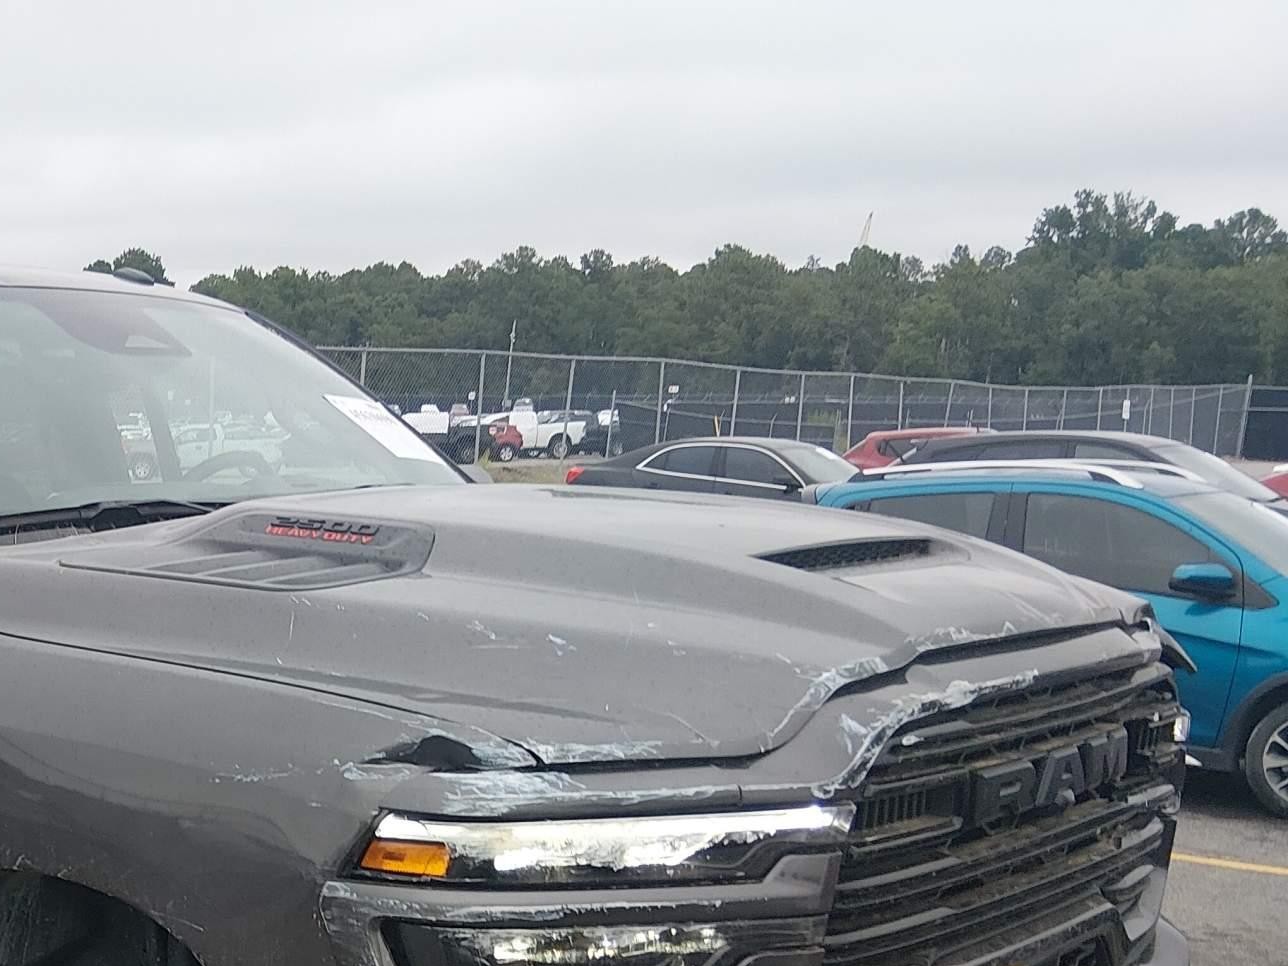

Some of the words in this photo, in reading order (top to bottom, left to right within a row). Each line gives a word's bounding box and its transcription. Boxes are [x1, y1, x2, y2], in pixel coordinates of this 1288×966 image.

[265, 523, 319, 540] HEAVY
[322, 531, 374, 545] DUTY
[270, 515, 382, 536] 2500
[974, 722, 1128, 824] RAM
